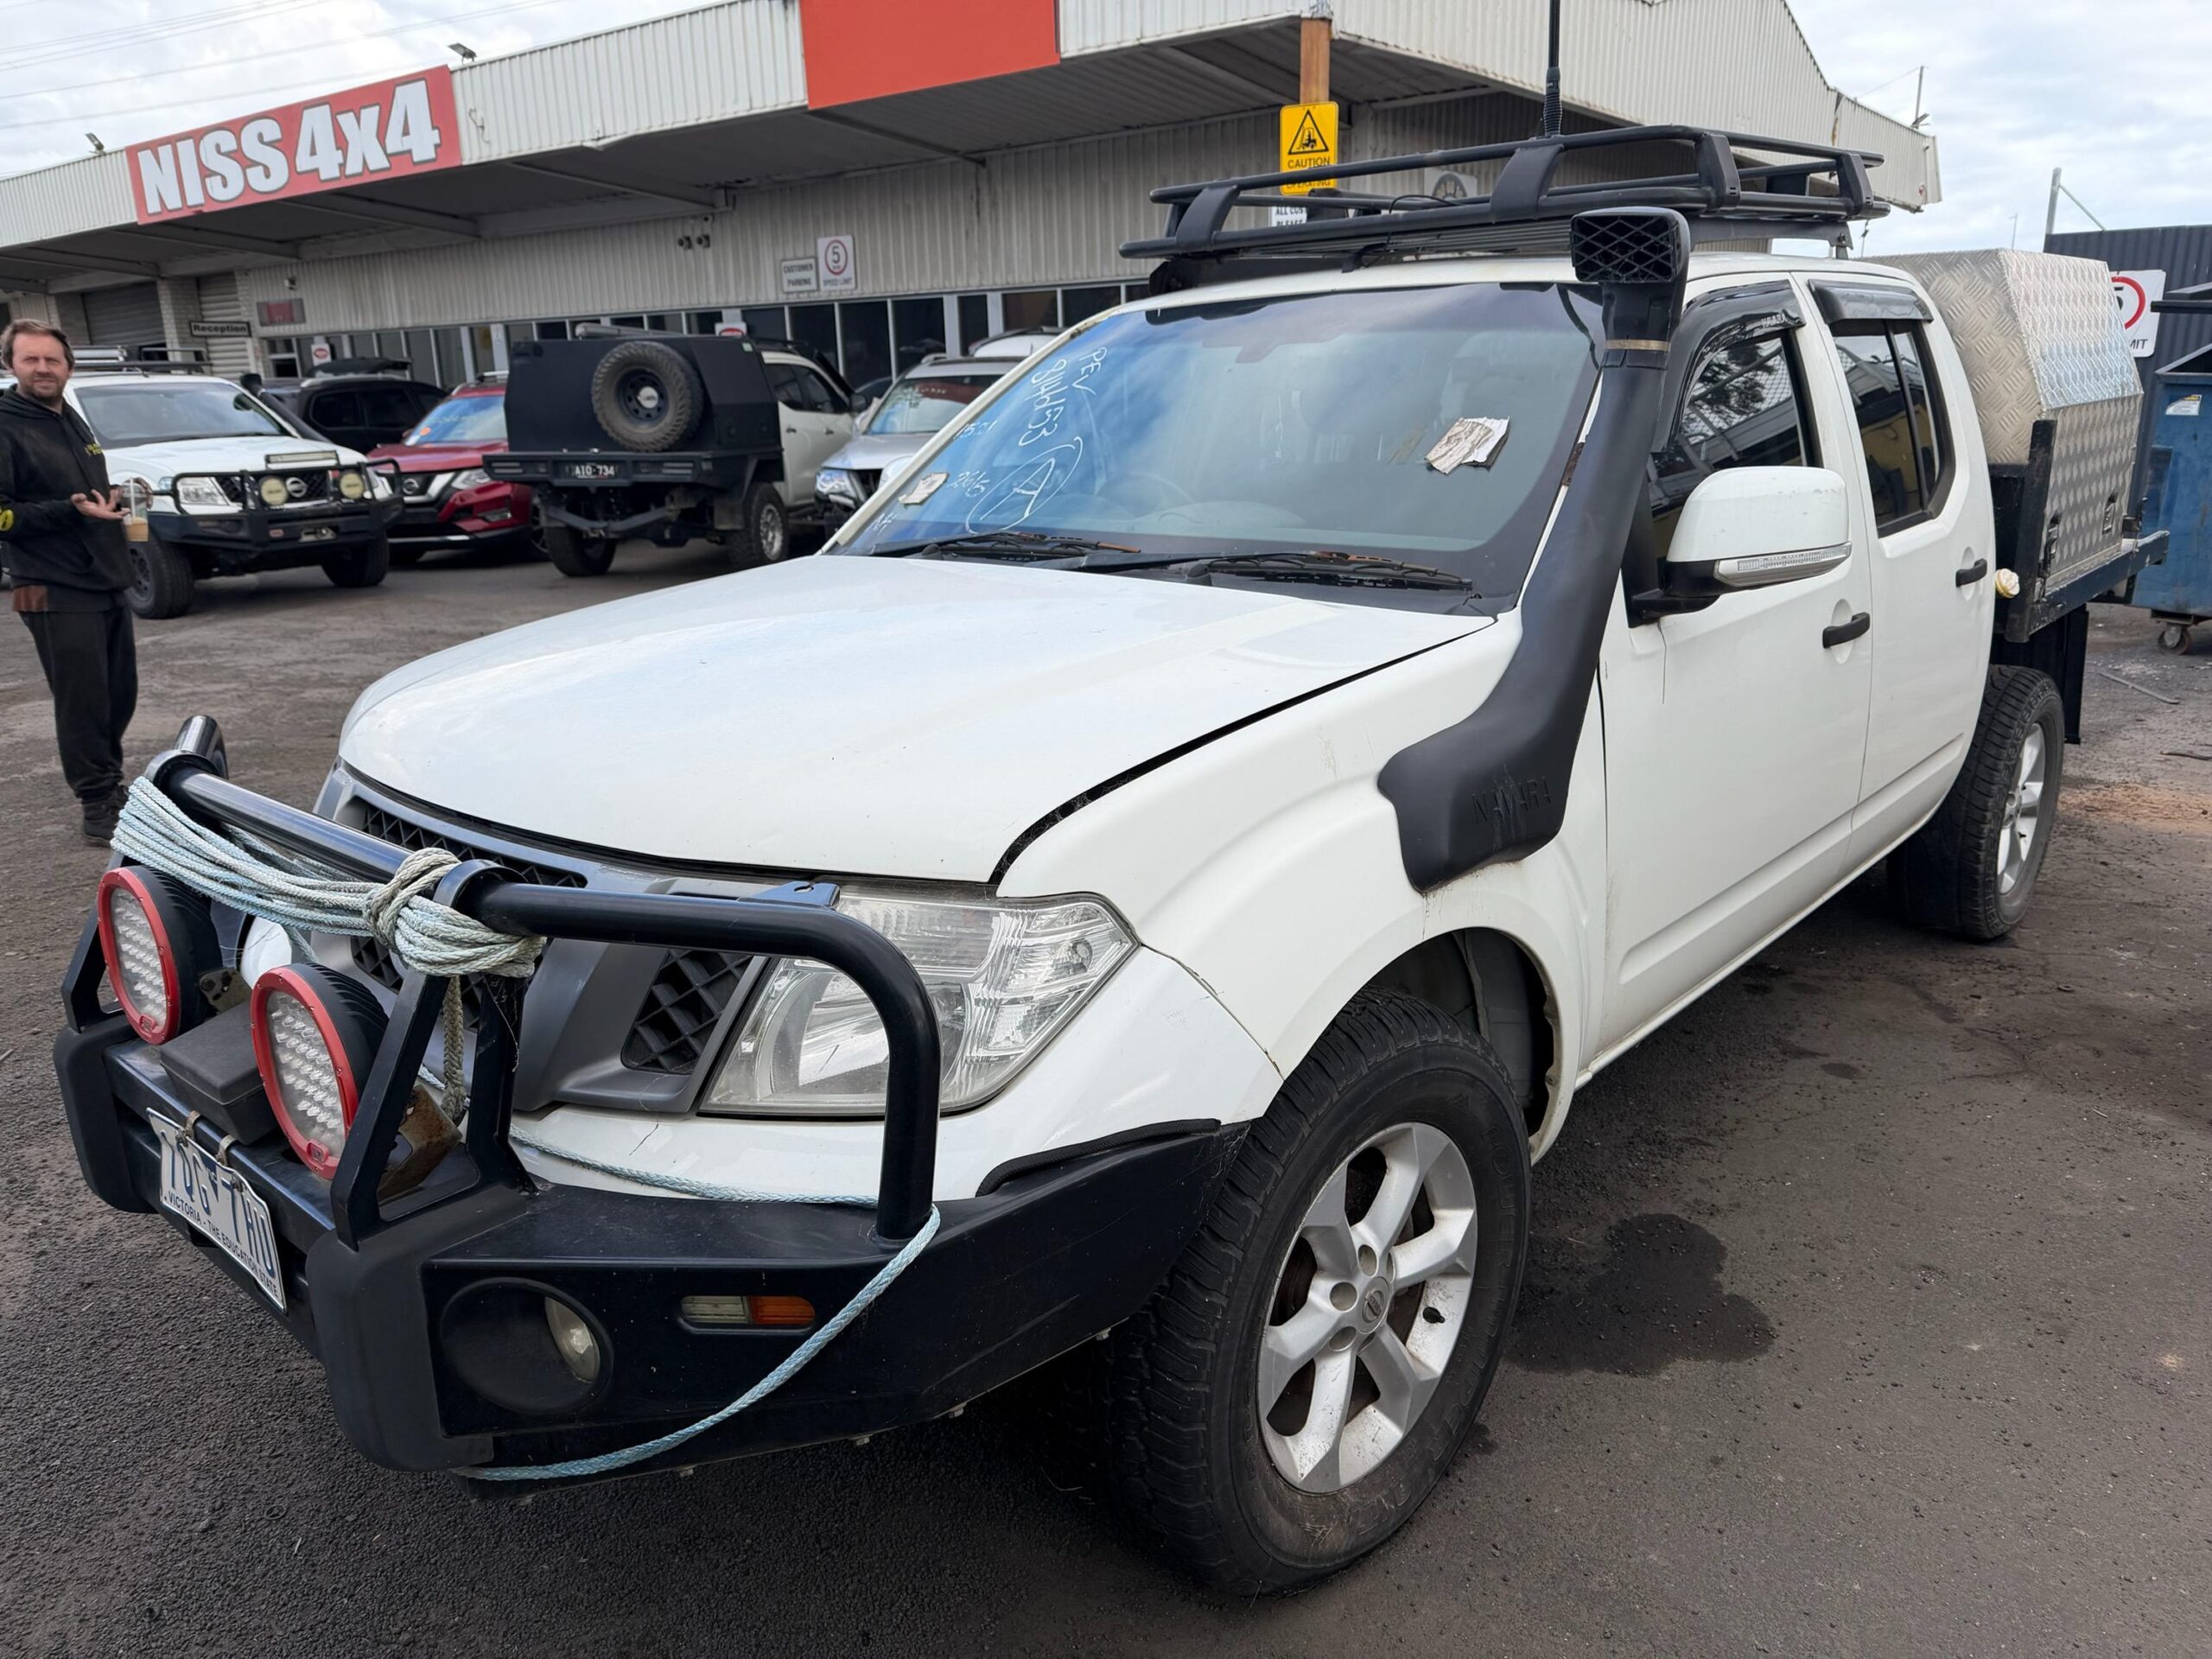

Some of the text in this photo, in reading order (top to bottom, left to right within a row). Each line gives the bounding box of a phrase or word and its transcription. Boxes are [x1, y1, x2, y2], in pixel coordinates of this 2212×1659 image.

[1287, 157, 1331, 169] CAUTION
[832, 245, 841, 264] 5
[193, 324, 247, 334] Reception
[168, 1190, 201, 1225] VICTORIA
[207, 1219, 221, 1241] THE
[221, 1231, 259, 1280] EDUCATION
[259, 1274, 278, 1298] STATE
